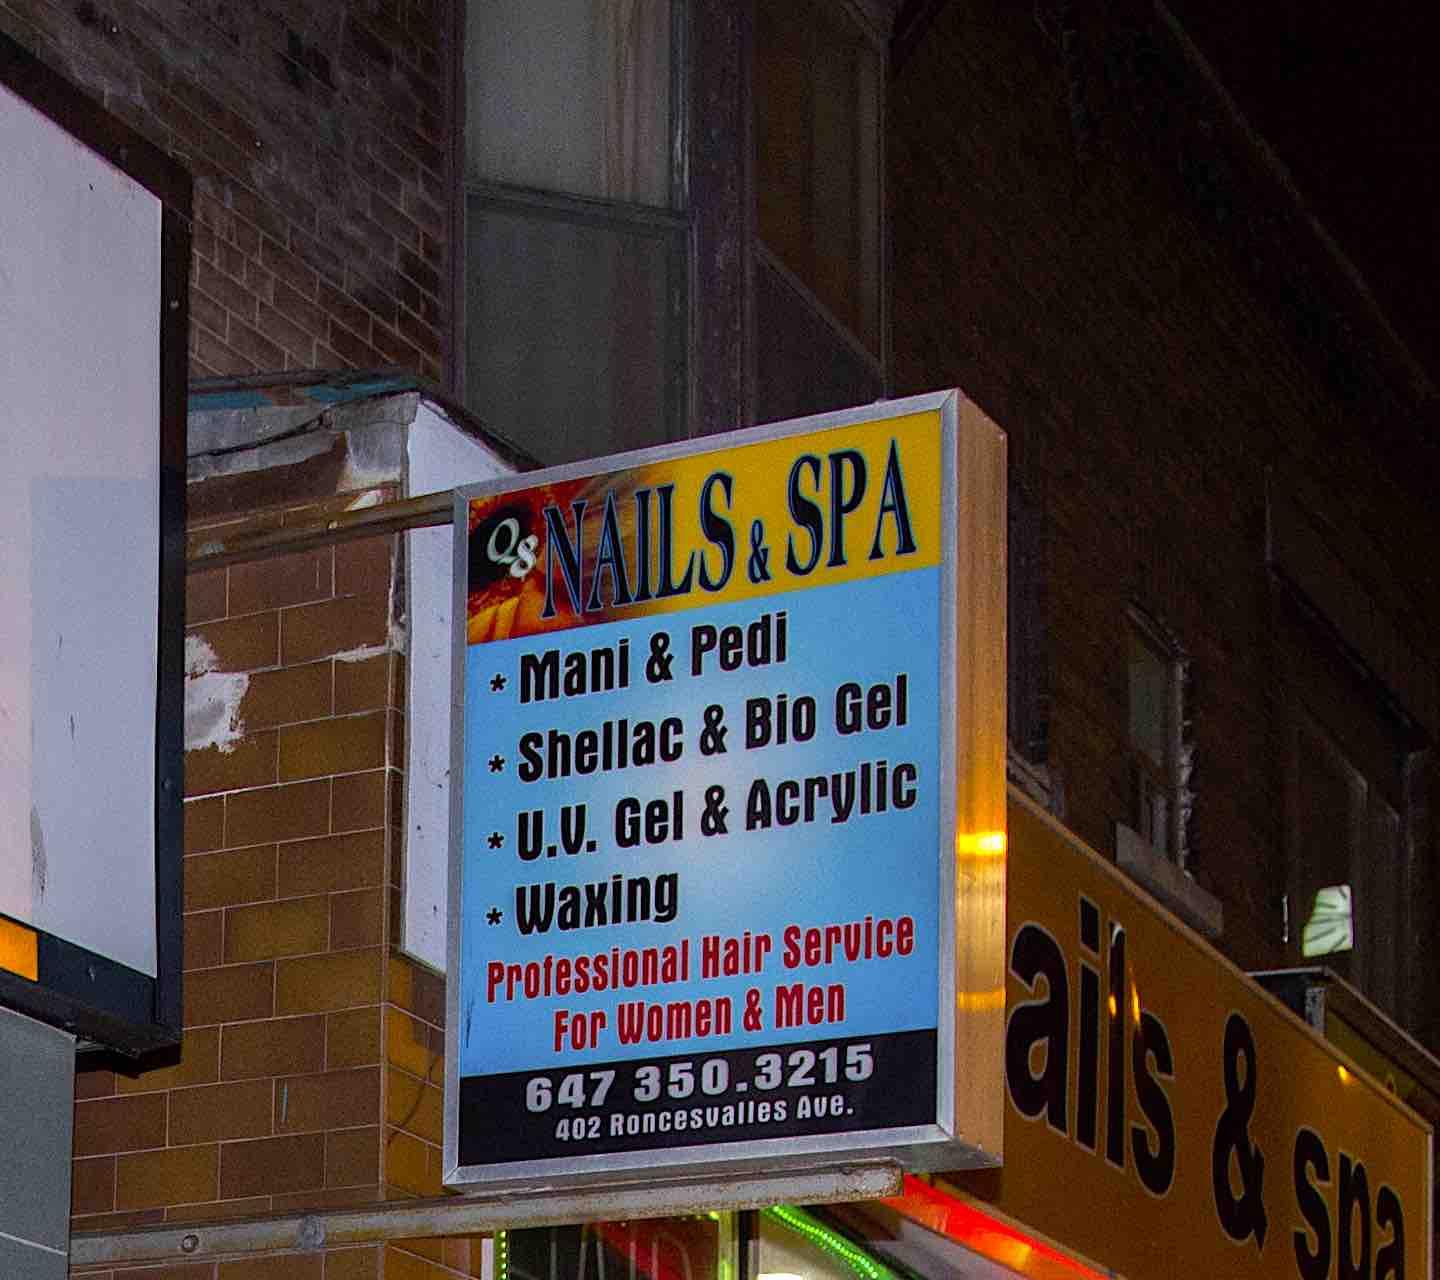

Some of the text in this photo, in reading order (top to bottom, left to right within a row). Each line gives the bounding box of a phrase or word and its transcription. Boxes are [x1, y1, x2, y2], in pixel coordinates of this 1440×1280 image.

[541, 472, 736, 620] NAILS
[748, 519, 771, 585] &
[786, 437, 917, 577] SPA
[519, 611, 787, 704] Mani & Pedi
[518, 674, 908, 783] Shellac & Bio Gel
[518, 760, 917, 861] U.V. Gel & Acrylic
[516, 872, 678, 936] Waxing
[486, 915, 914, 1003] Professional Hair Service
[554, 983, 845, 1052] For Women & Men
[525, 1044, 874, 1113] 647 350.3215
[555, 1094, 853, 1142] 402 Roncesvalles Ave.
[1212, 1009, 1268, 1254] &
